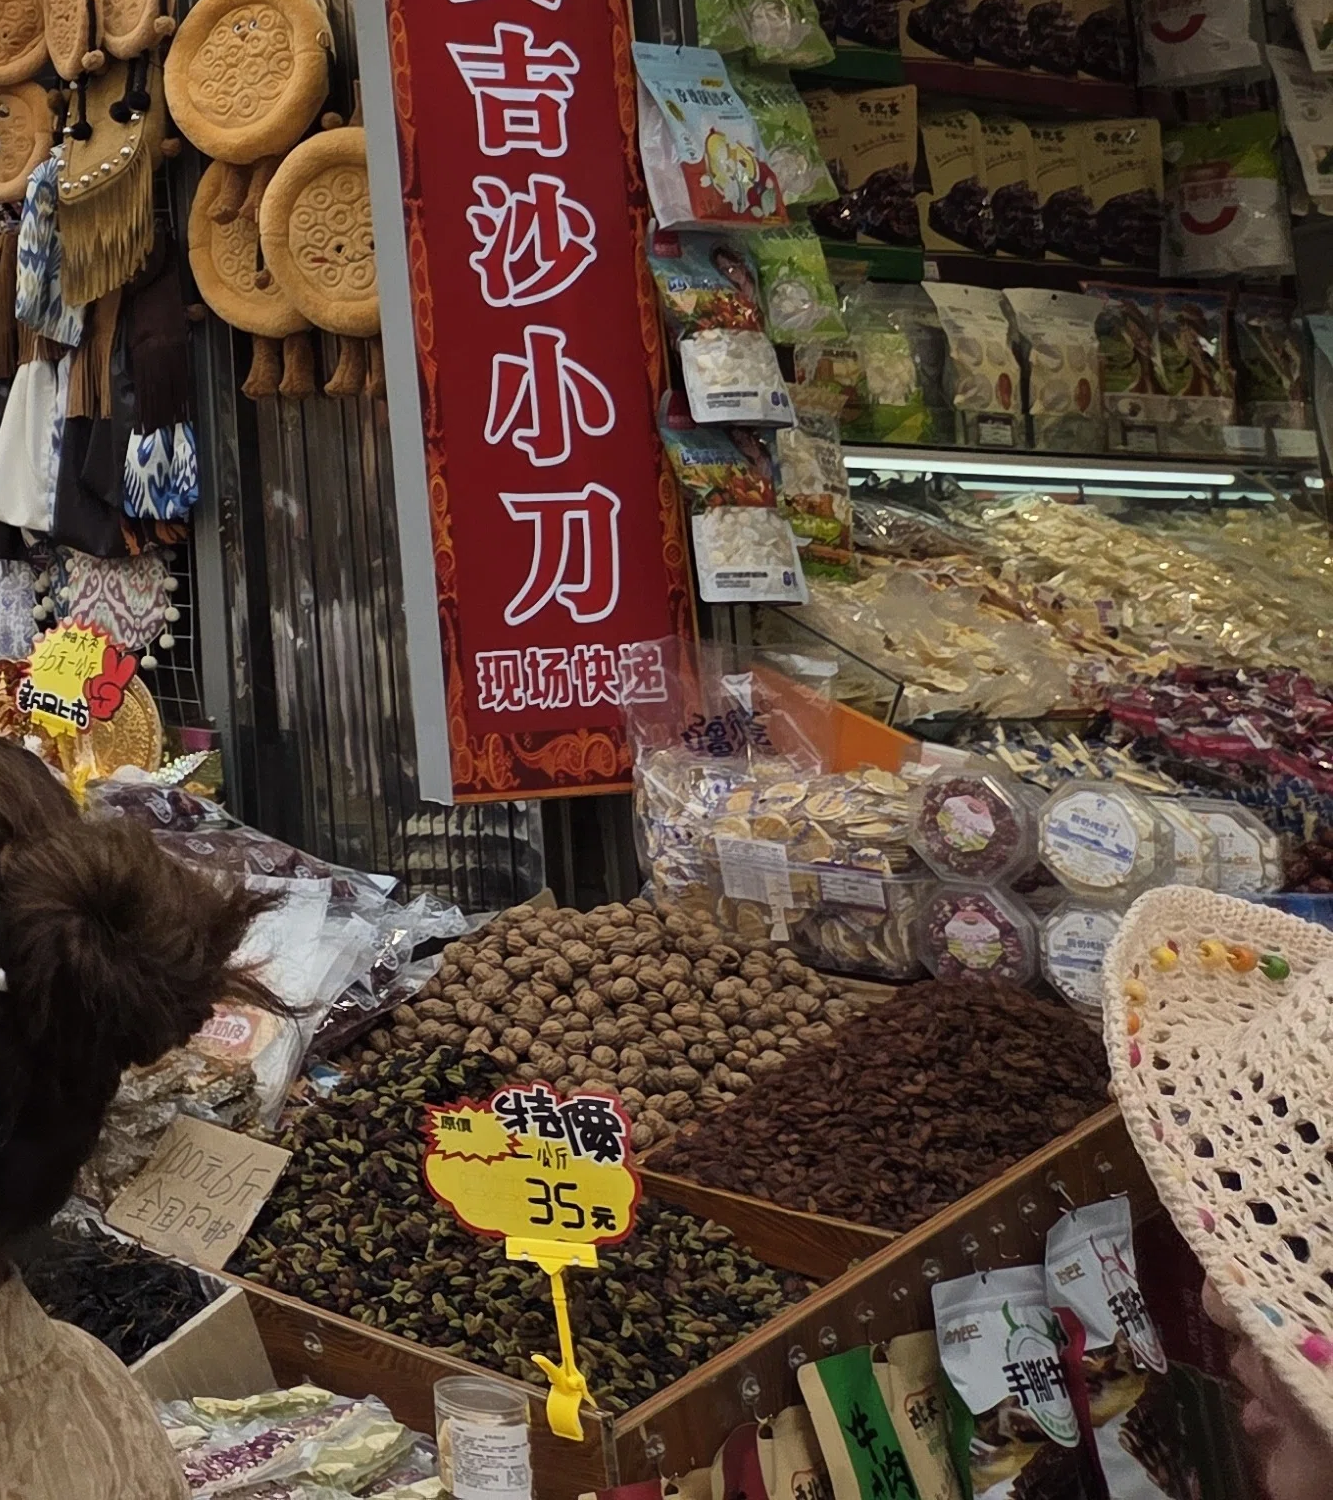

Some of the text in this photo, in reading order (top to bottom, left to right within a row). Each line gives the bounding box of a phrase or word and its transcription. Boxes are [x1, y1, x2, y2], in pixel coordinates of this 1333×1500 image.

[18, 679, 90, 728] 新品上市
[476, 639, 667, 711] 现场快递
[494, 1087, 625, 1163] 特價
[126, 1177, 236, 1249] 全国包邮
